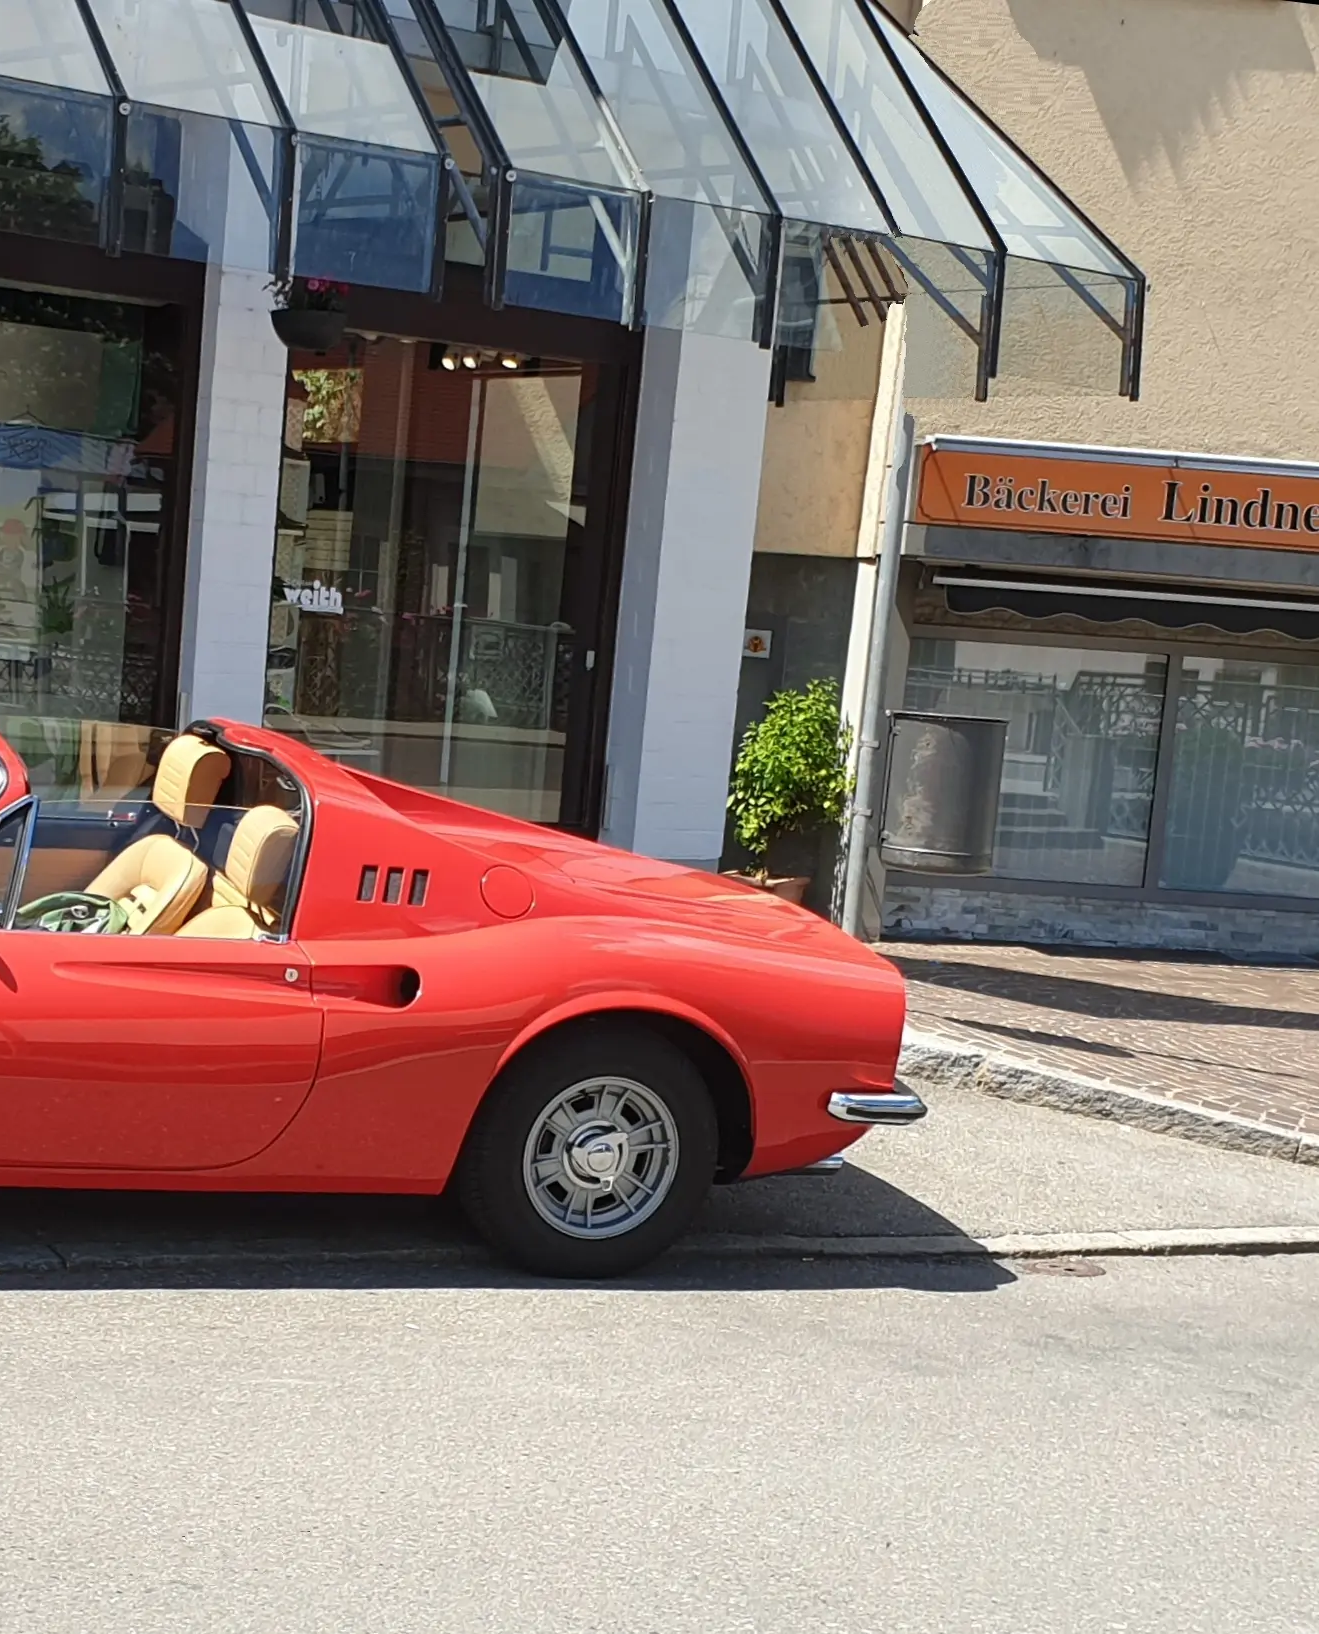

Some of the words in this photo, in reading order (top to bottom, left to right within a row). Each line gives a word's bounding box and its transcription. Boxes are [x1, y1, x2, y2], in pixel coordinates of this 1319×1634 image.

[962, 473, 1132, 519] Bäckerei
[1158, 480, 1319, 534] Lindne
[283, 580, 342, 607] weith
